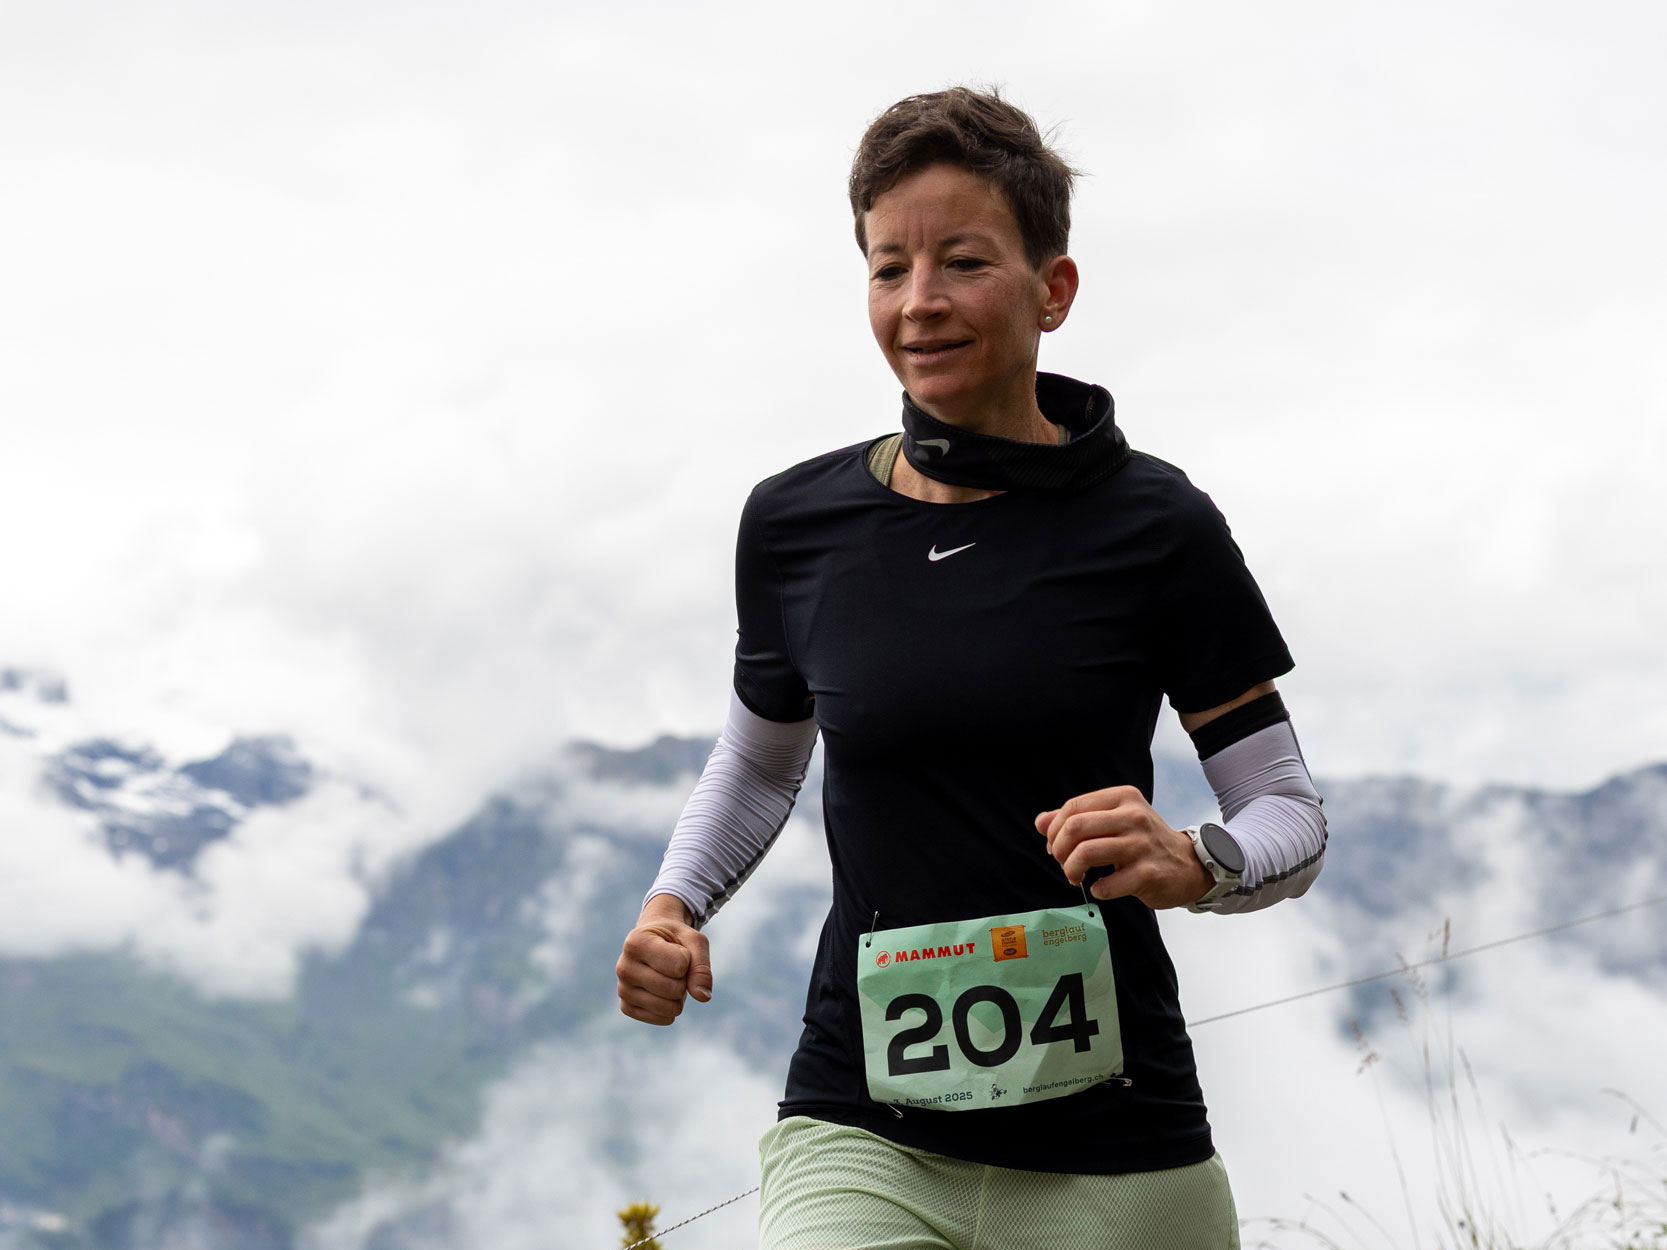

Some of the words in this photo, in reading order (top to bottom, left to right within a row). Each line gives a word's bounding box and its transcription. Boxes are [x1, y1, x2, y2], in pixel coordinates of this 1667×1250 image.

[1042, 923, 1086, 938] berglauf
[1043, 933, 1087, 947] engelberg
[895, 942, 976, 963] MAMMUT
[885, 972, 1100, 1077] 204
[1022, 1073, 1104, 1094] berglaufengelberg.ch
[905, 1096, 942, 1107] August
[944, 1091, 974, 1103] 2025
